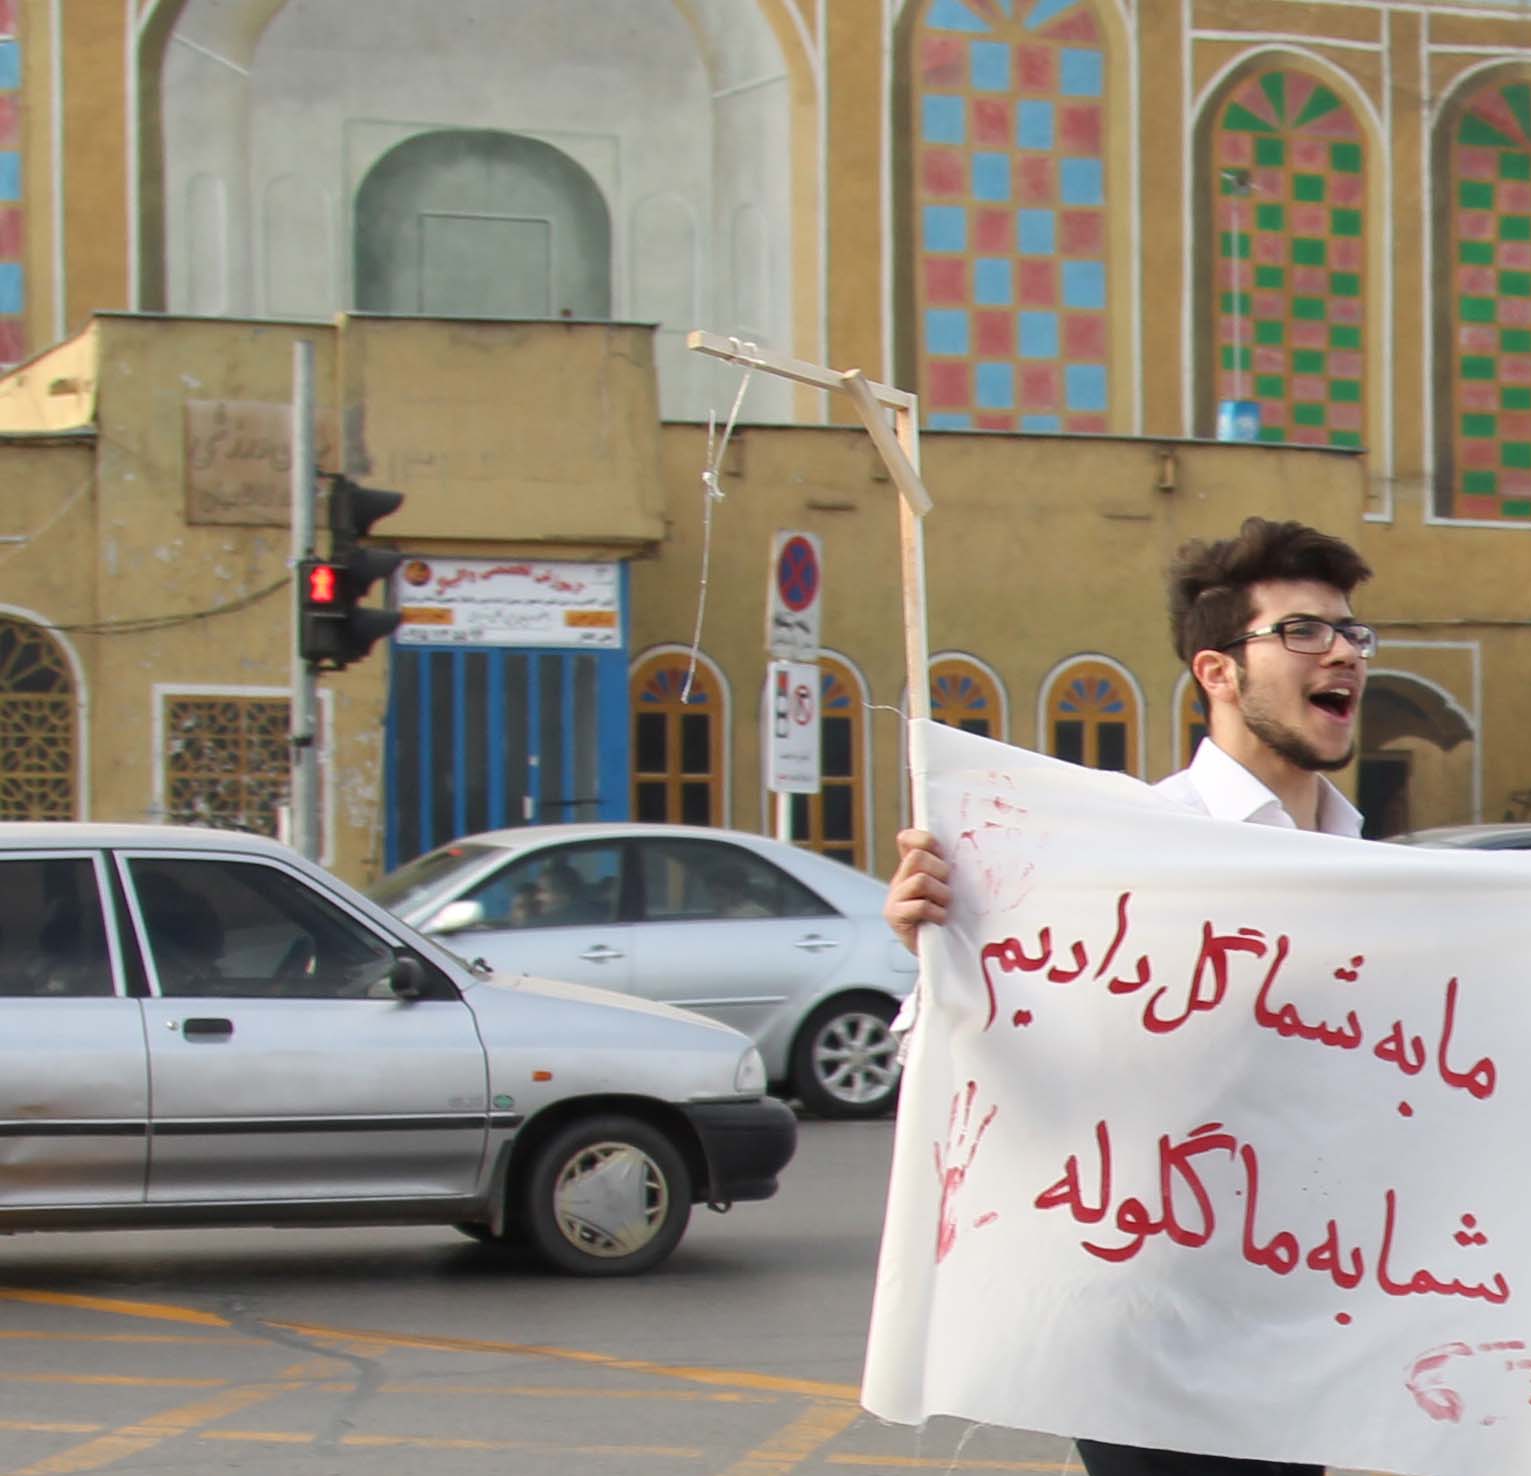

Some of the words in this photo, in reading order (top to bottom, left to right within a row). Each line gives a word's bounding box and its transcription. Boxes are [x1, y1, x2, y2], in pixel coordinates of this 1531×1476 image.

[981, 892, 1151, 1030] دادیم
[1142, 921, 1266, 1034] گل
[1253, 936, 1364, 1050] شما
[1373, 1020, 1426, 1117] به
[1438, 977, 1496, 1099] ما
[1033, 1120, 1238, 1263] گلوله
[1241, 1143, 1300, 1275] ما
[1376, 1190, 1510, 1305] شما
[1306, 1219, 1365, 1326] به
